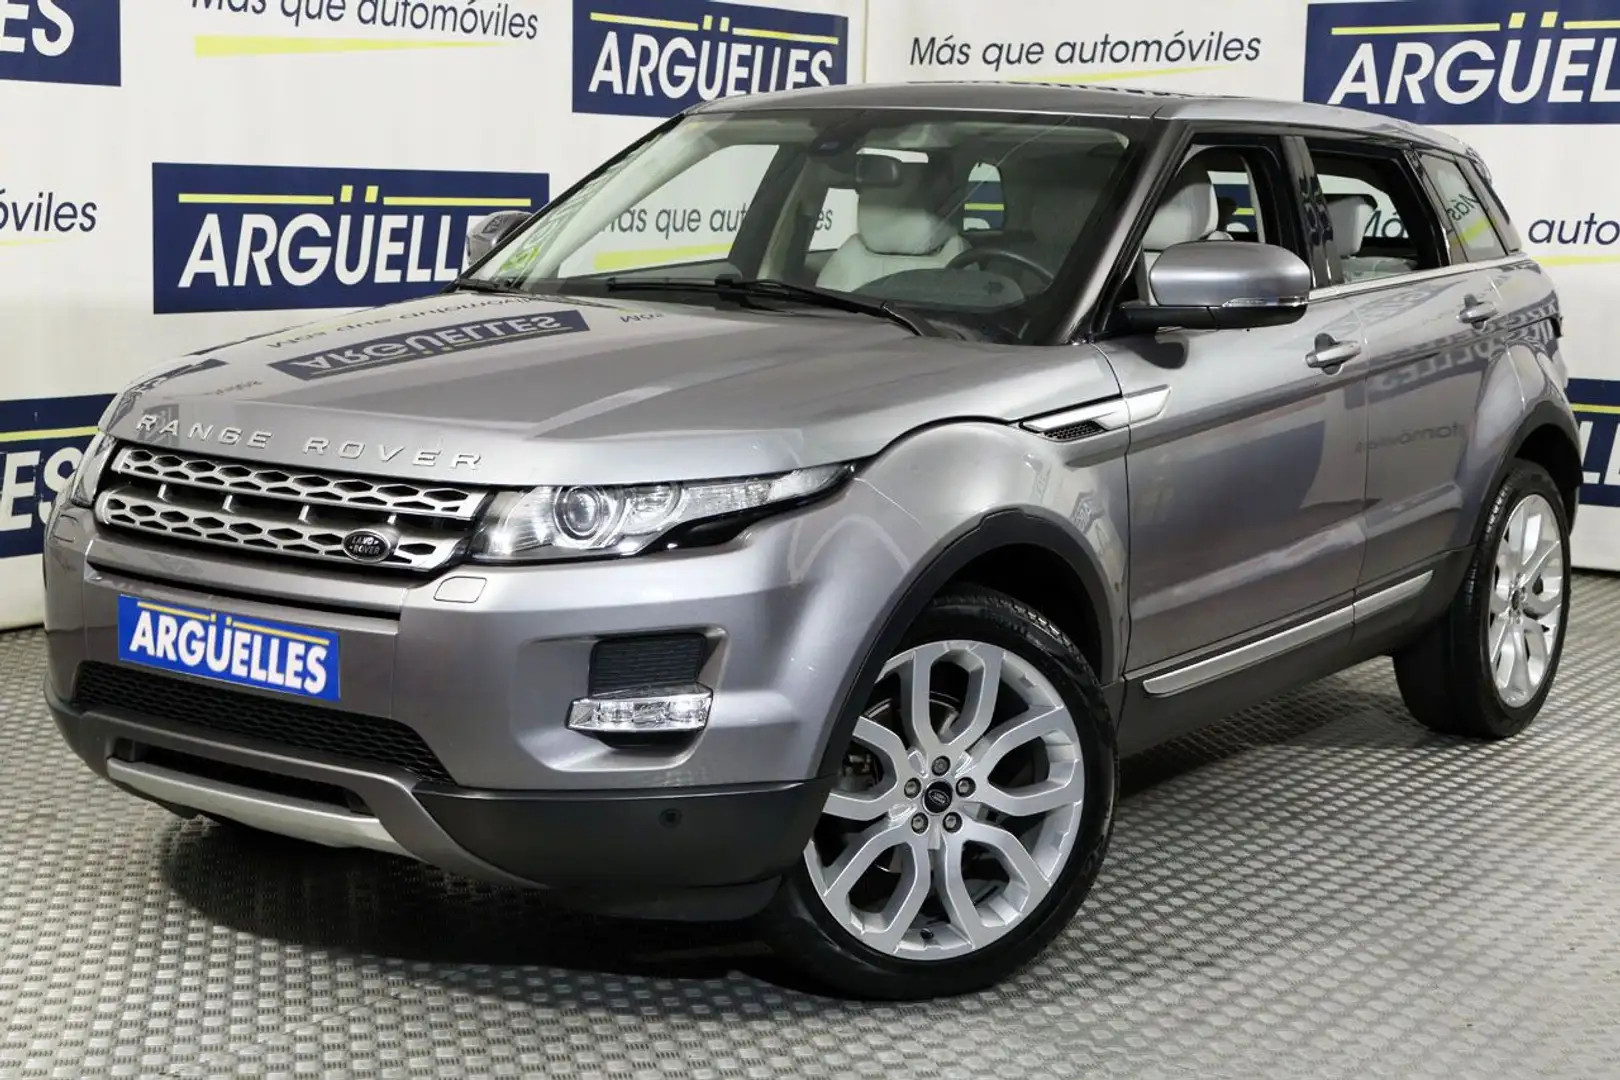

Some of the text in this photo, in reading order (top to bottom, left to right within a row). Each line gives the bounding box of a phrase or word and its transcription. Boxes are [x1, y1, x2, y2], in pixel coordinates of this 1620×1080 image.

[909, 30, 1262, 72] Más que automóviles
[178, 185, 484, 289] ARGÜELL
[655, 207, 701, 240] que
[135, 414, 482, 471] RANGE ROVER
[129, 612, 328, 694] ARGÜELLES
